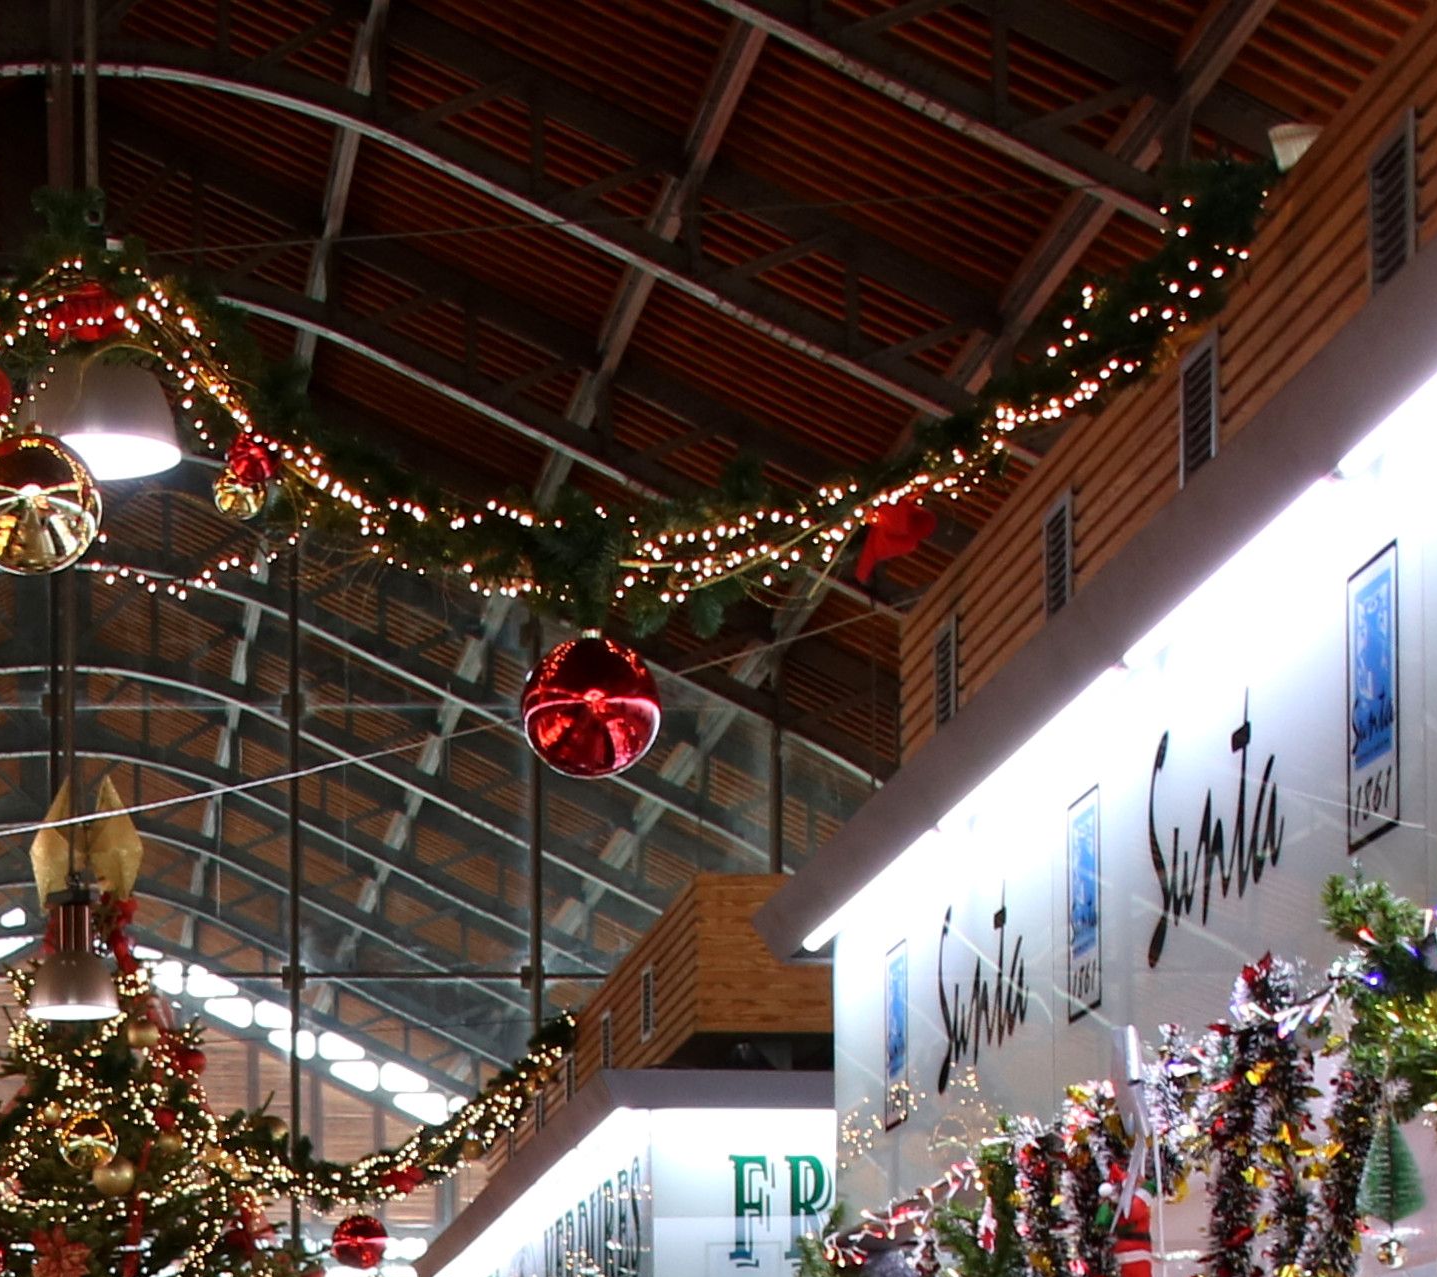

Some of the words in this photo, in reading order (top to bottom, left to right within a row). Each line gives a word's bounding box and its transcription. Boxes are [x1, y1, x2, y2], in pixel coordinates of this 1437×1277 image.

[1147, 687, 1286, 969] Sunta
[1354, 765, 1392, 828] 1861
[936, 878, 1032, 1095] Sunta
